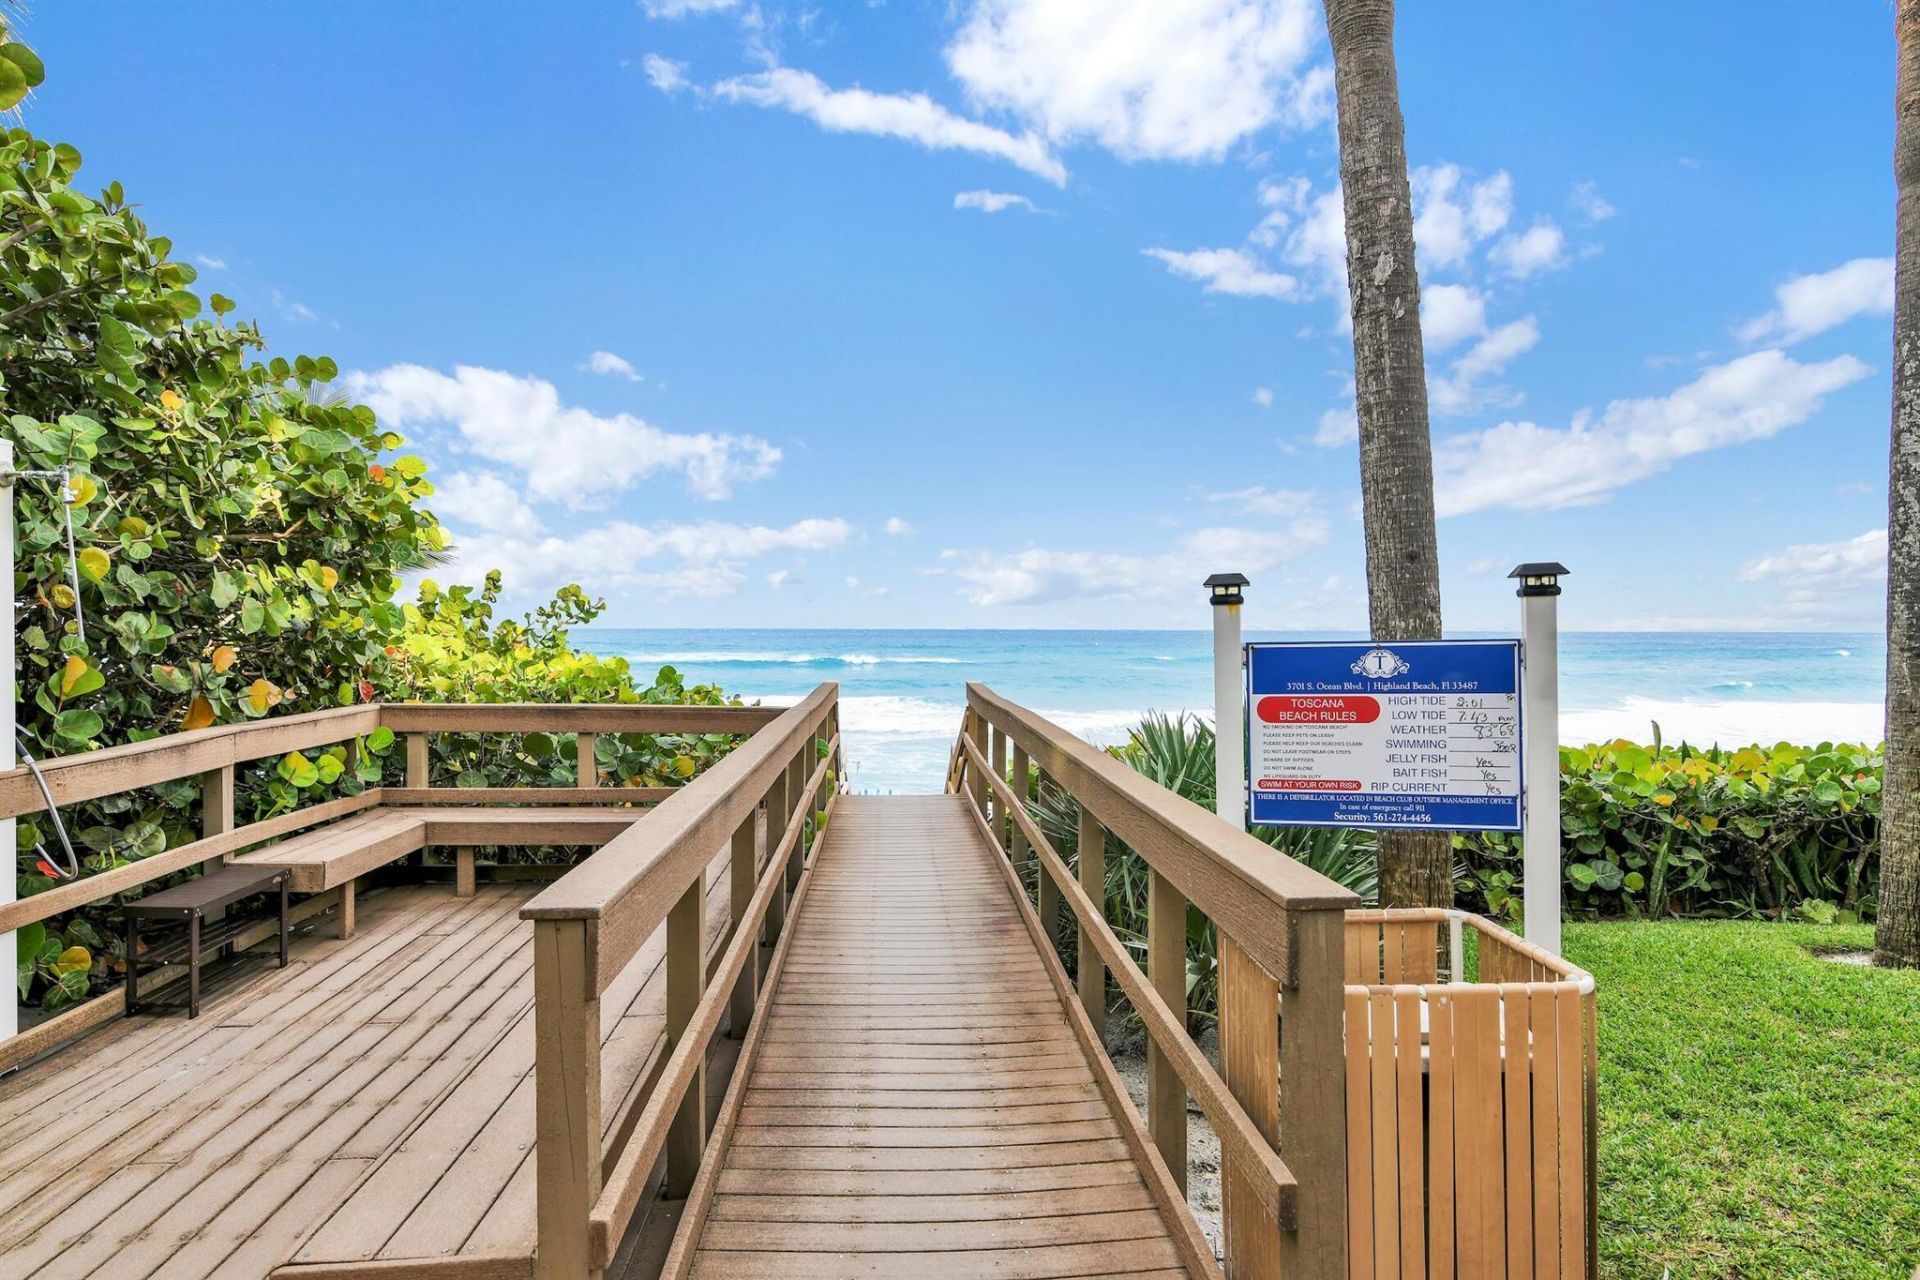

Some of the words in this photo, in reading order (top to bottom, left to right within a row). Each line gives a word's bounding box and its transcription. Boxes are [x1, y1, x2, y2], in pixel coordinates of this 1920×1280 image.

[1286, 682, 1305, 691] 3701
[1307, 682, 1315, 690] S.
[1317, 682, 1341, 690] Ocean
[1344, 682, 1364, 690] Blvd.
[1374, 682, 1410, 691] Highland
[1412, 682, 1439, 690] Beach,
[1453, 681, 1478, 689] 33487
[1291, 699, 1344, 708] TOSCANA
[1388, 697, 1417, 705] HIGH
[1420, 697, 1446, 705] TIDE
[1280, 711, 1317, 721] BEACH
[1320, 712, 1357, 721] RULES
[1392, 711, 1418, 719] LOW
[1421, 711, 1446, 719] TIDE
[1391, 725, 1447, 734] WEATHER
[1385, 740, 1447, 749] SWIMMING
[1385, 754, 1418, 763] JELLY
[1421, 754, 1447, 763] FISH
[1393, 768, 1418, 777] BAIT
[1421, 769, 1447, 777] FISH
[1371, 783, 1389, 791] RIP
[1392, 783, 1447, 792] CURRENT
[1334, 812, 1371, 822] Security:
[1373, 813, 1431, 822] 561-274-4456
